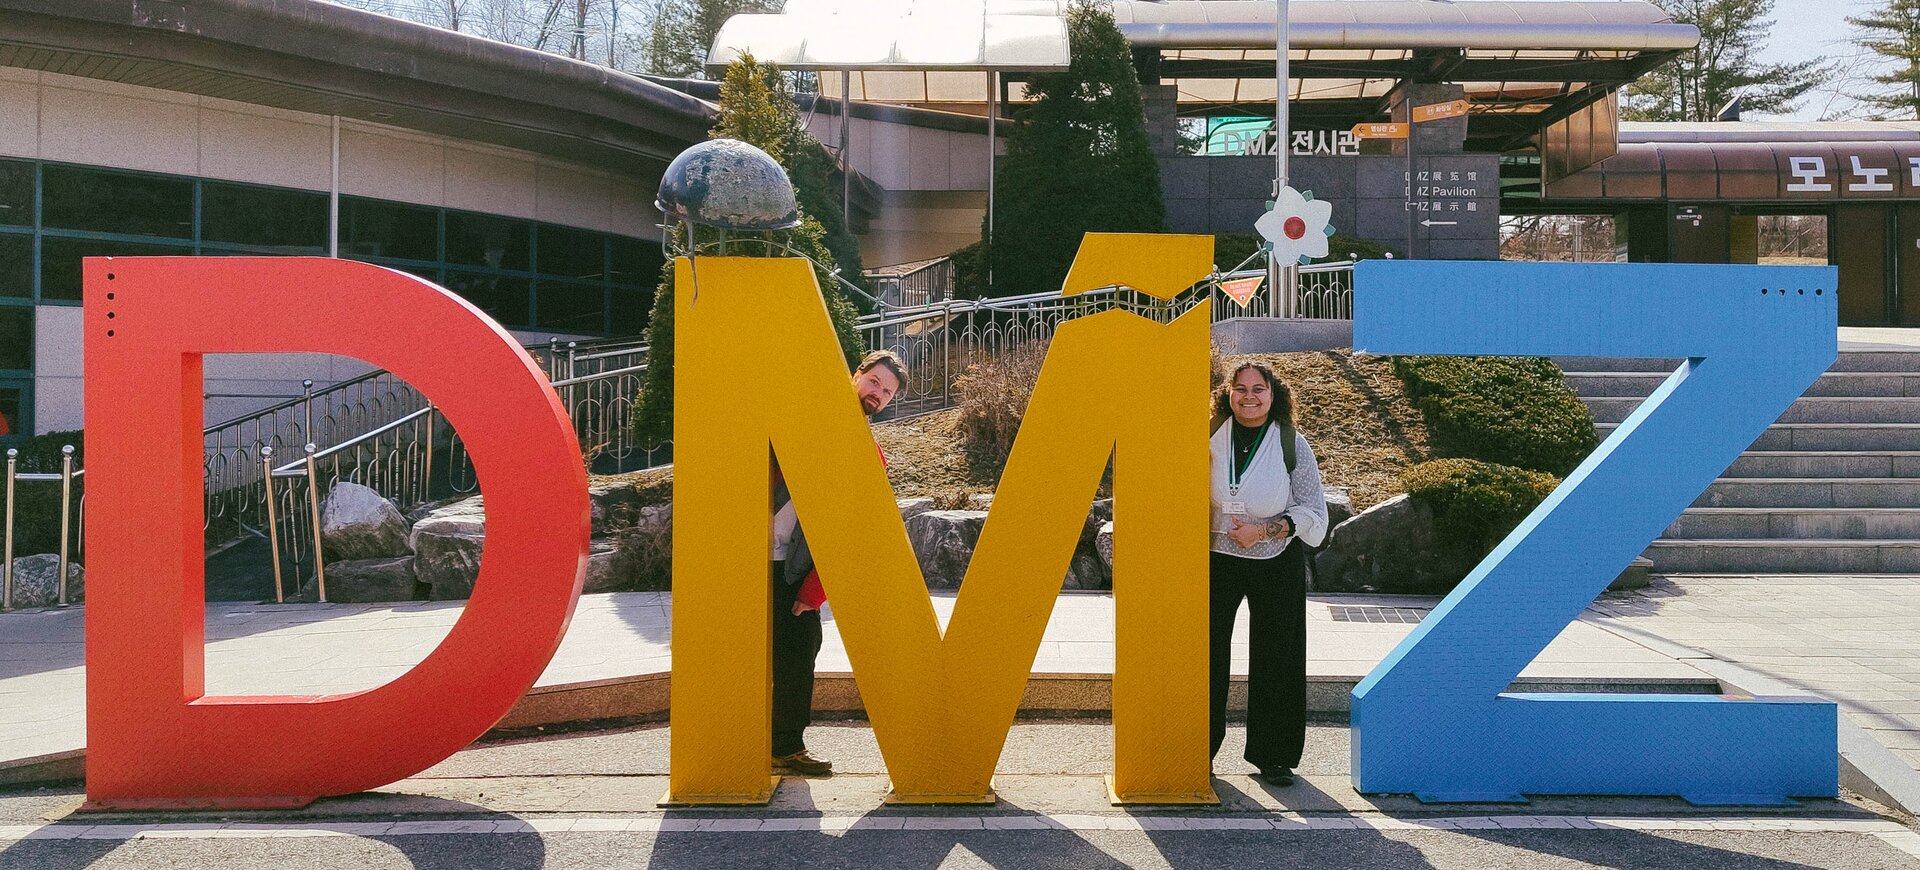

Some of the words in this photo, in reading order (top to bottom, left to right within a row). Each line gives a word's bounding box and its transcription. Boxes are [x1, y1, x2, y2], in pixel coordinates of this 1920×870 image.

[1291, 130, 1361, 155] 전시관
[1433, 186, 1476, 196] Pavilion
[84, 232, 1840, 808] DMZ
